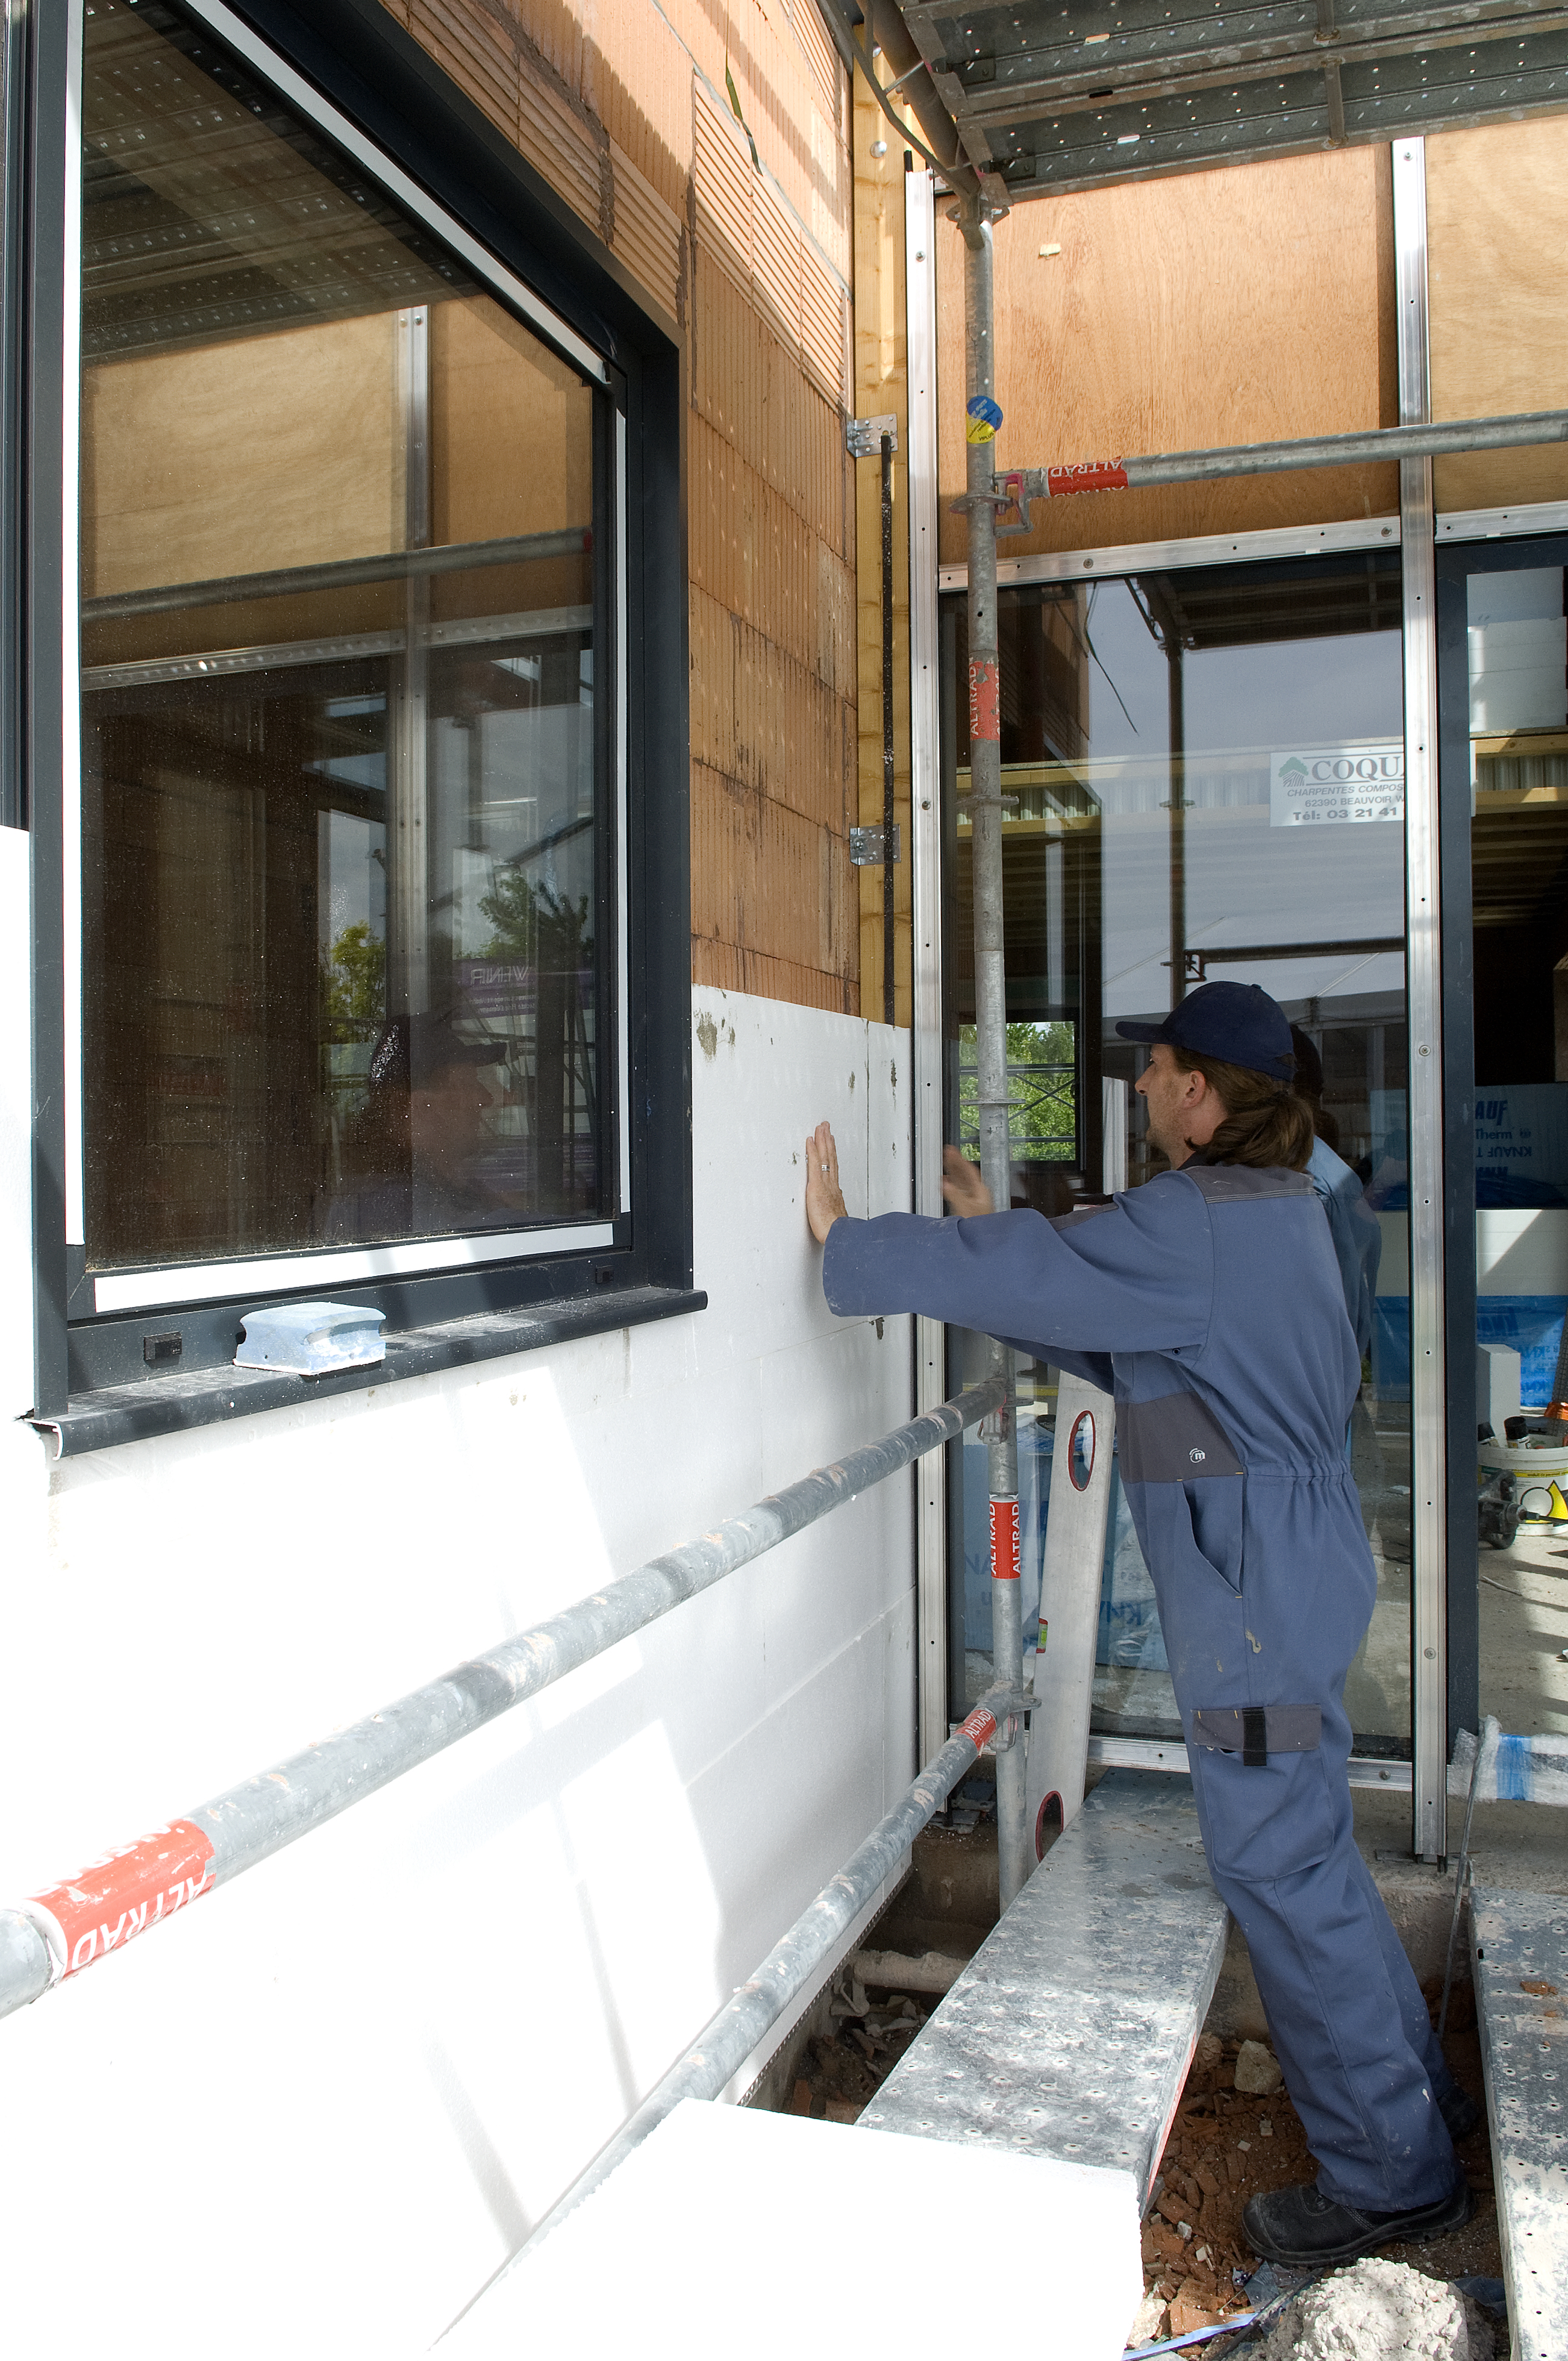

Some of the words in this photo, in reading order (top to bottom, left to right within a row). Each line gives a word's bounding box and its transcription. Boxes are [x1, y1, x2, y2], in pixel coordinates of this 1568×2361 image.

[1311, 755, 1404, 781] COQU
[1287, 785, 1355, 797] CHARPENTES
[1305, 798, 1337, 807] 62390
[1340, 795, 1392, 805] BEAUVOIR
[1293, 810, 1321, 821] Tél:
[1327, 809, 1349, 819] 03
[1355, 808, 1373, 818] 21
[1378, 807, 1397, 816] 41
[965, 1710, 992, 1739] ALTRAD
